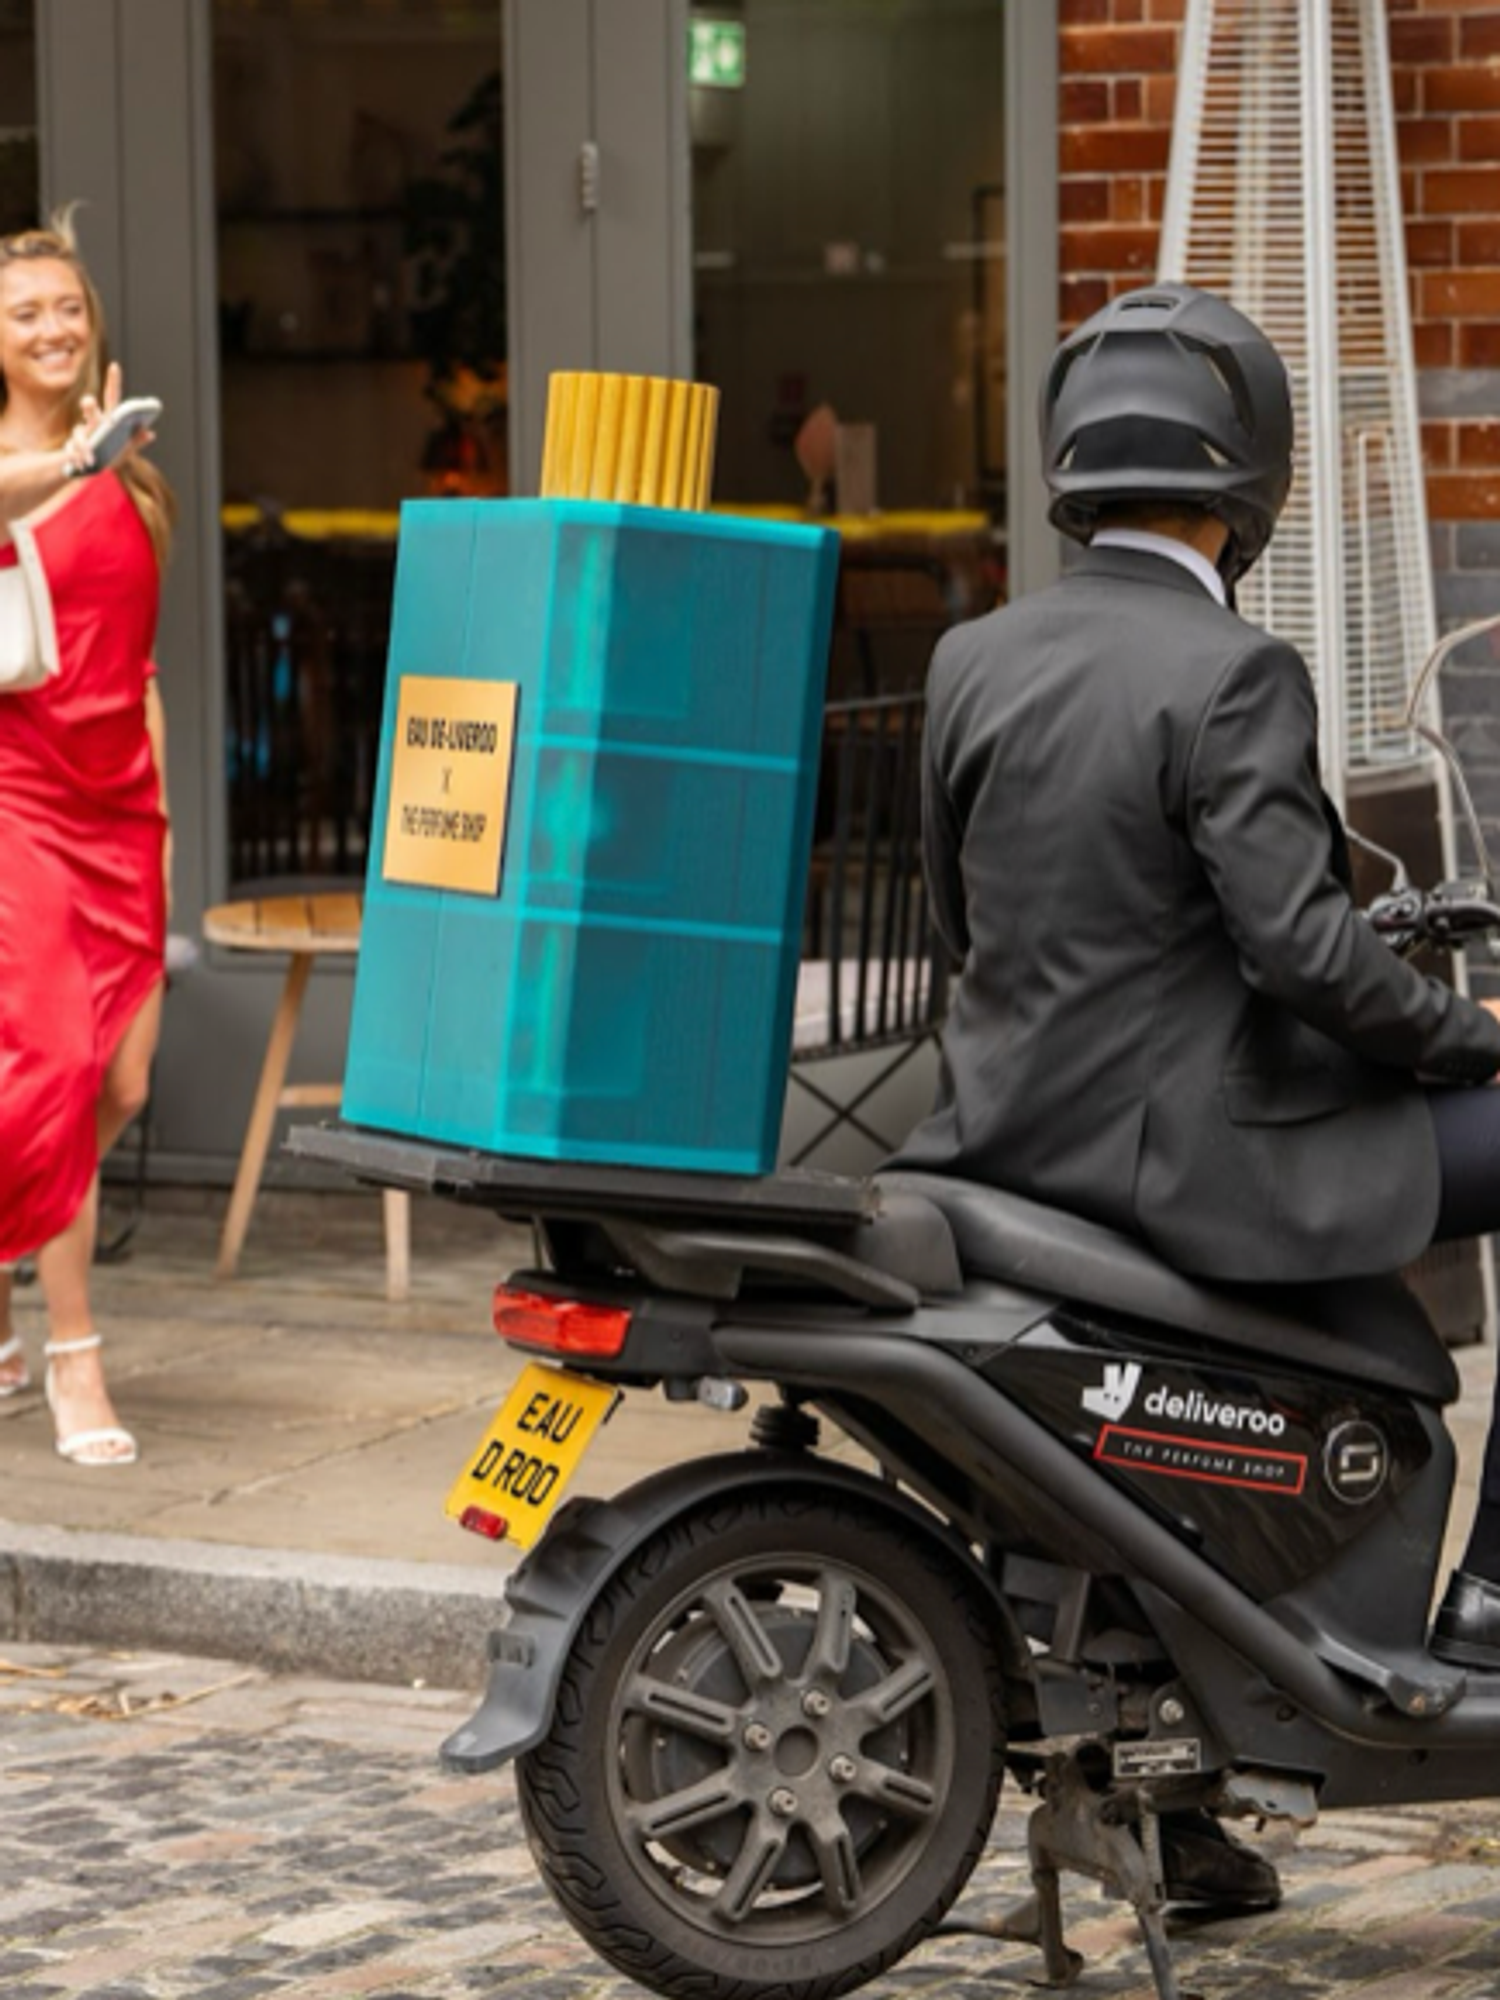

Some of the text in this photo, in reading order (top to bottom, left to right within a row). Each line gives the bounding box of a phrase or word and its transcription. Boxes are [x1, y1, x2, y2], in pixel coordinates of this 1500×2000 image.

[517, 1392, 584, 1444] EAU
[1144, 1386, 1286, 1436] deliveroo
[472, 1439, 504, 1480] D
[1123, 1440, 1285, 1477] THE PERFUME SHOP
